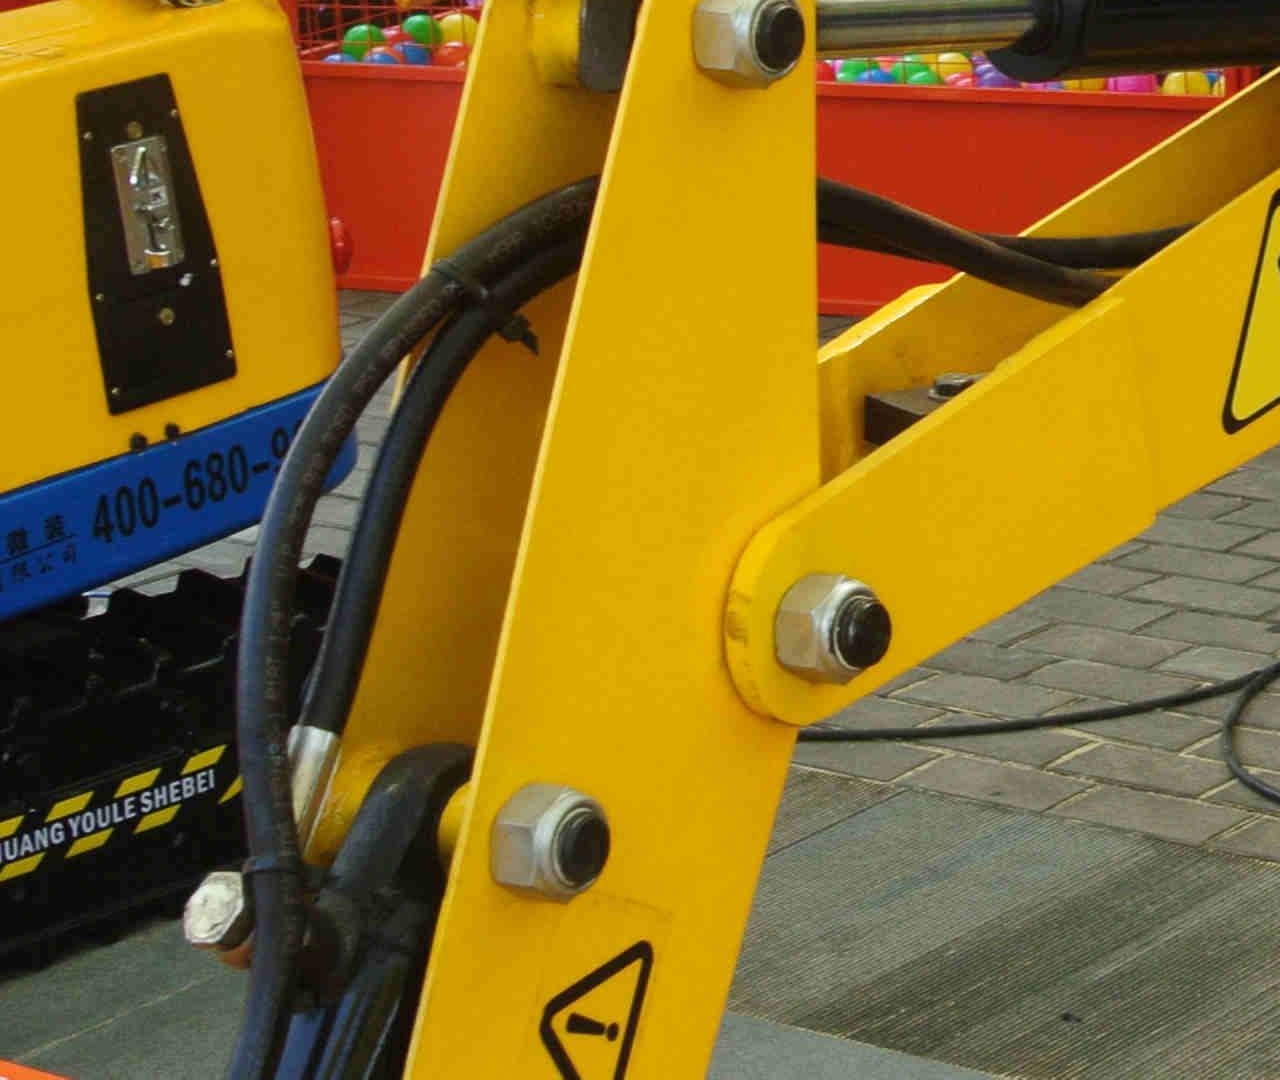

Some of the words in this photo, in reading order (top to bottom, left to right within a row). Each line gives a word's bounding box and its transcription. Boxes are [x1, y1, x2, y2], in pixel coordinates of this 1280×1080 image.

[91, 422, 300, 544] 400-680-9
[67, 795, 137, 838] YOULE
[140, 767, 216, 814] SHEBEI
